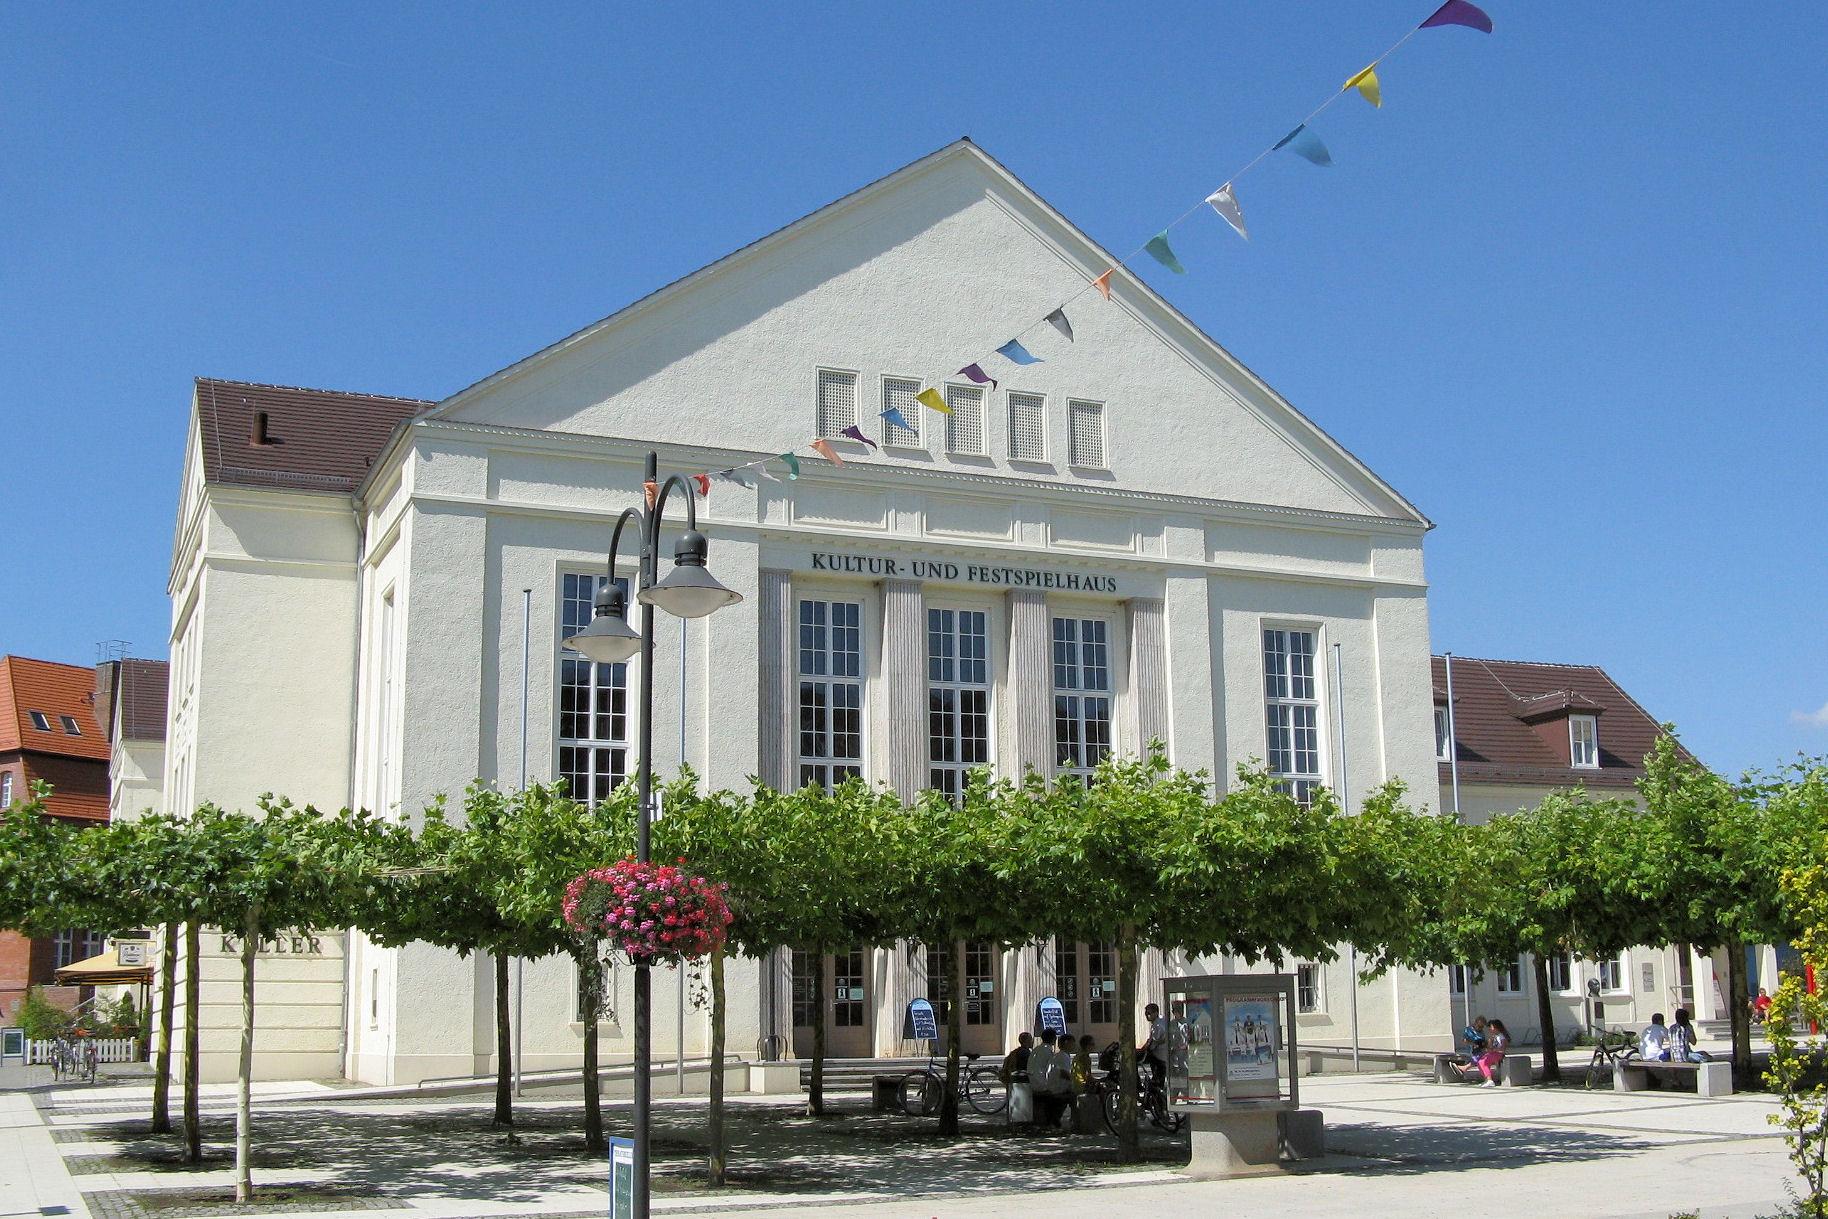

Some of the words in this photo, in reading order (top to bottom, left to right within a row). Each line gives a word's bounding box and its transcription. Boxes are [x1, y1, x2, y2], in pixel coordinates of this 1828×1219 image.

[811, 553, 905, 575] KULTUR-
[912, 561, 959, 580] UND
[967, 566, 1117, 592] FESTSPIELHAUS
[220, 936, 322, 954] KLLER
